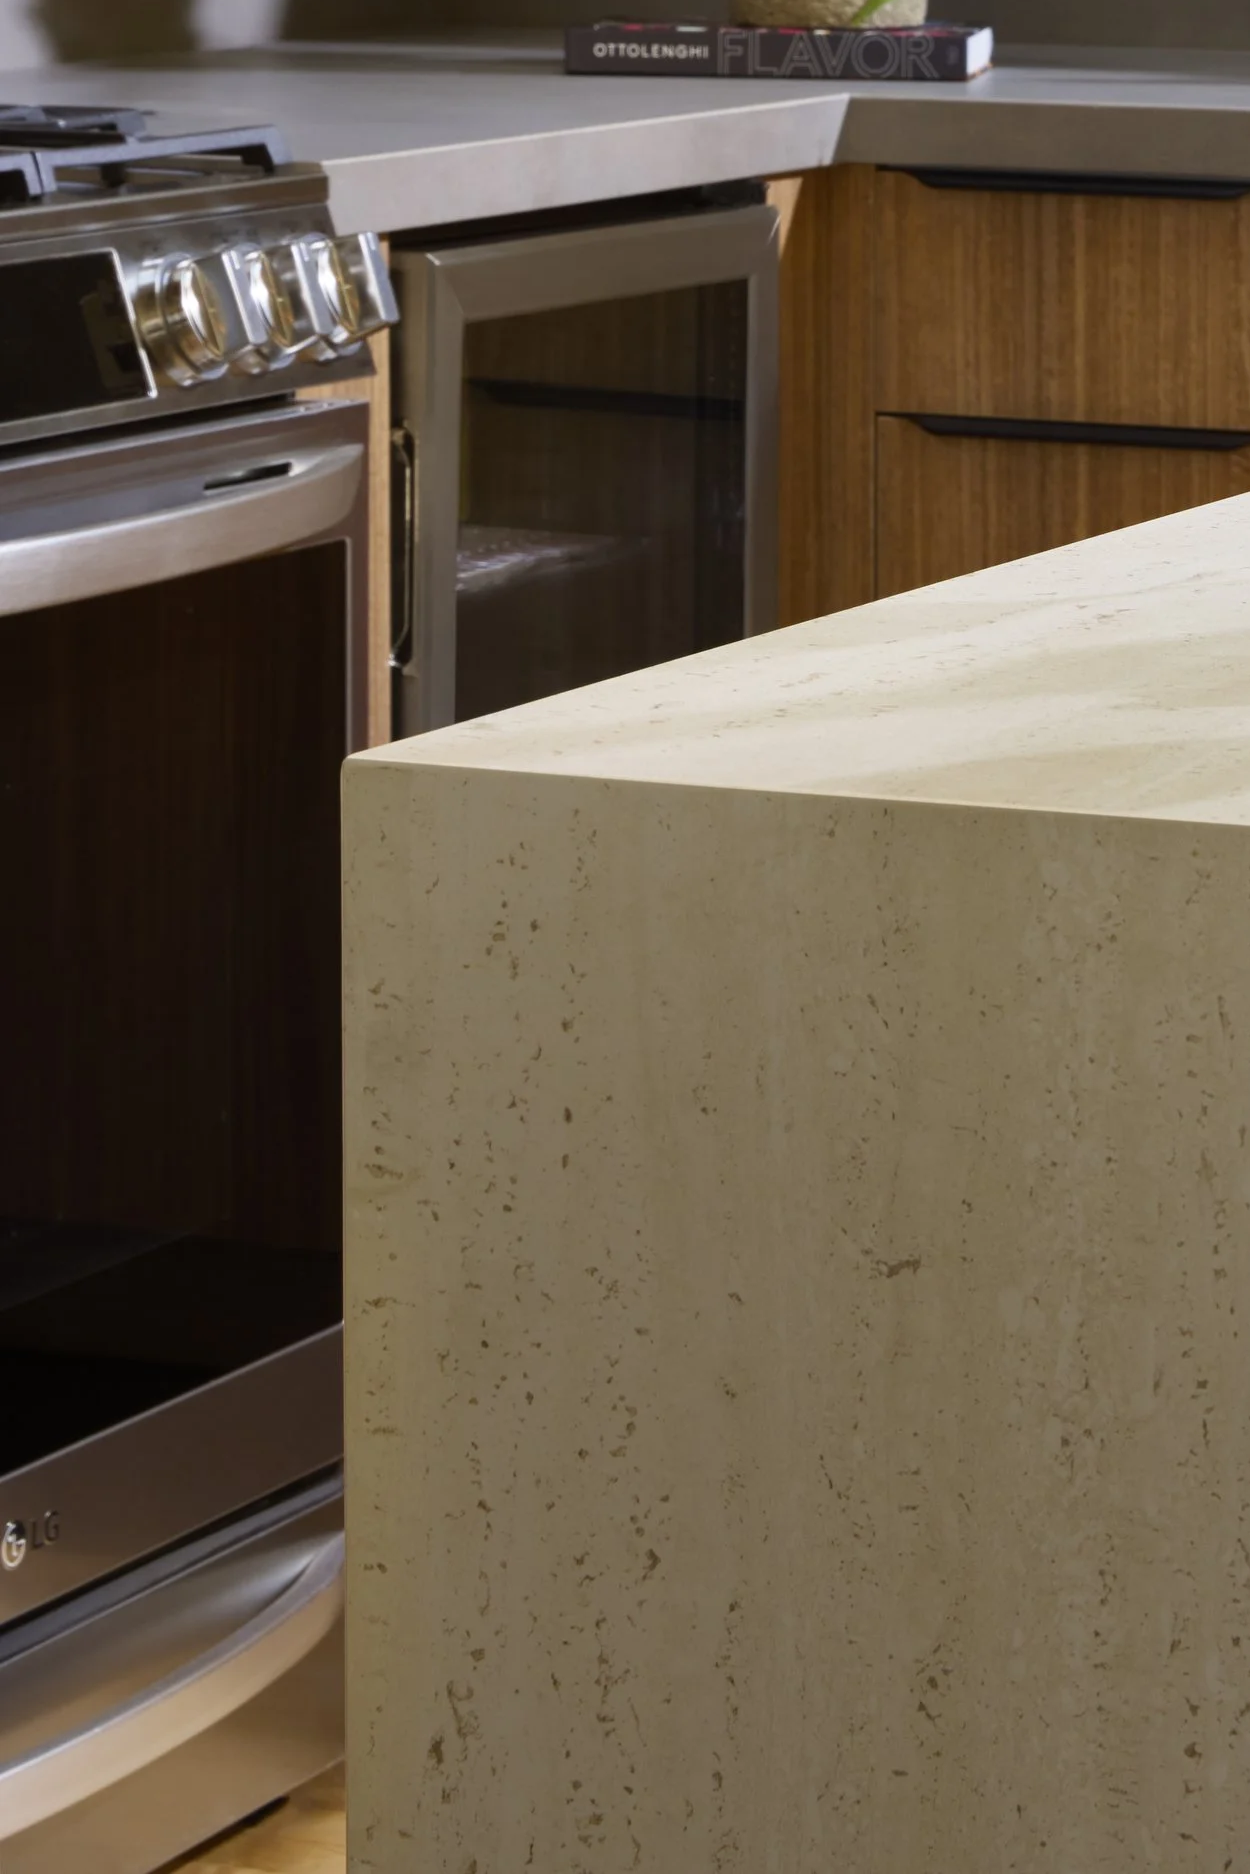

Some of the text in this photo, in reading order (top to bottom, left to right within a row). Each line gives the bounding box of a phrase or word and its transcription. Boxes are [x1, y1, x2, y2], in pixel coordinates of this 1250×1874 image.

[592, 30, 940, 78] OTTOLENGHI FLAVOR
[29, 1510, 60, 1551] LG
